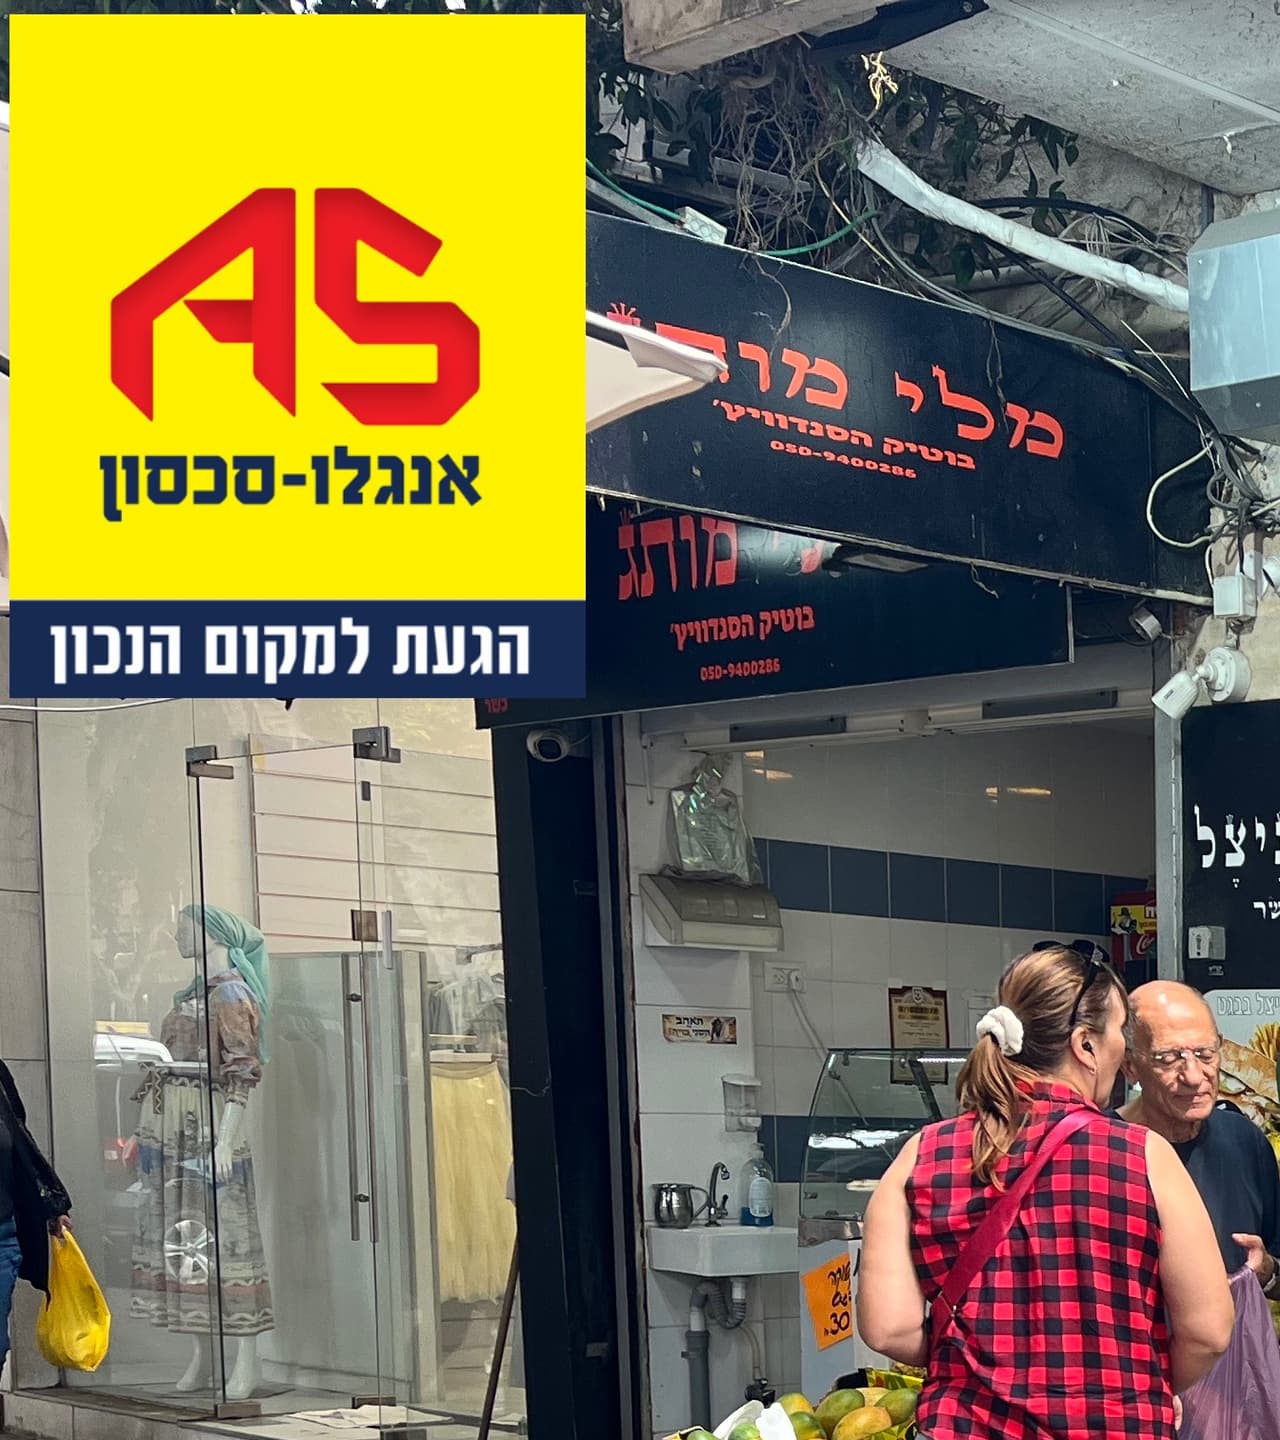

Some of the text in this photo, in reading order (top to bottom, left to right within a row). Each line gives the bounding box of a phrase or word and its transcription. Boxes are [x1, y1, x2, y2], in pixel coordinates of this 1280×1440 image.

[894, 363, 1064, 460] מלי
[769, 440, 917, 479] 050-9400286
[882, 432, 976, 470] בוטיק
[759, 605, 816, 641] בוטיק
[700, 658, 781, 681] 050-9400286
[1217, 996, 1252, 1016] בבגט
